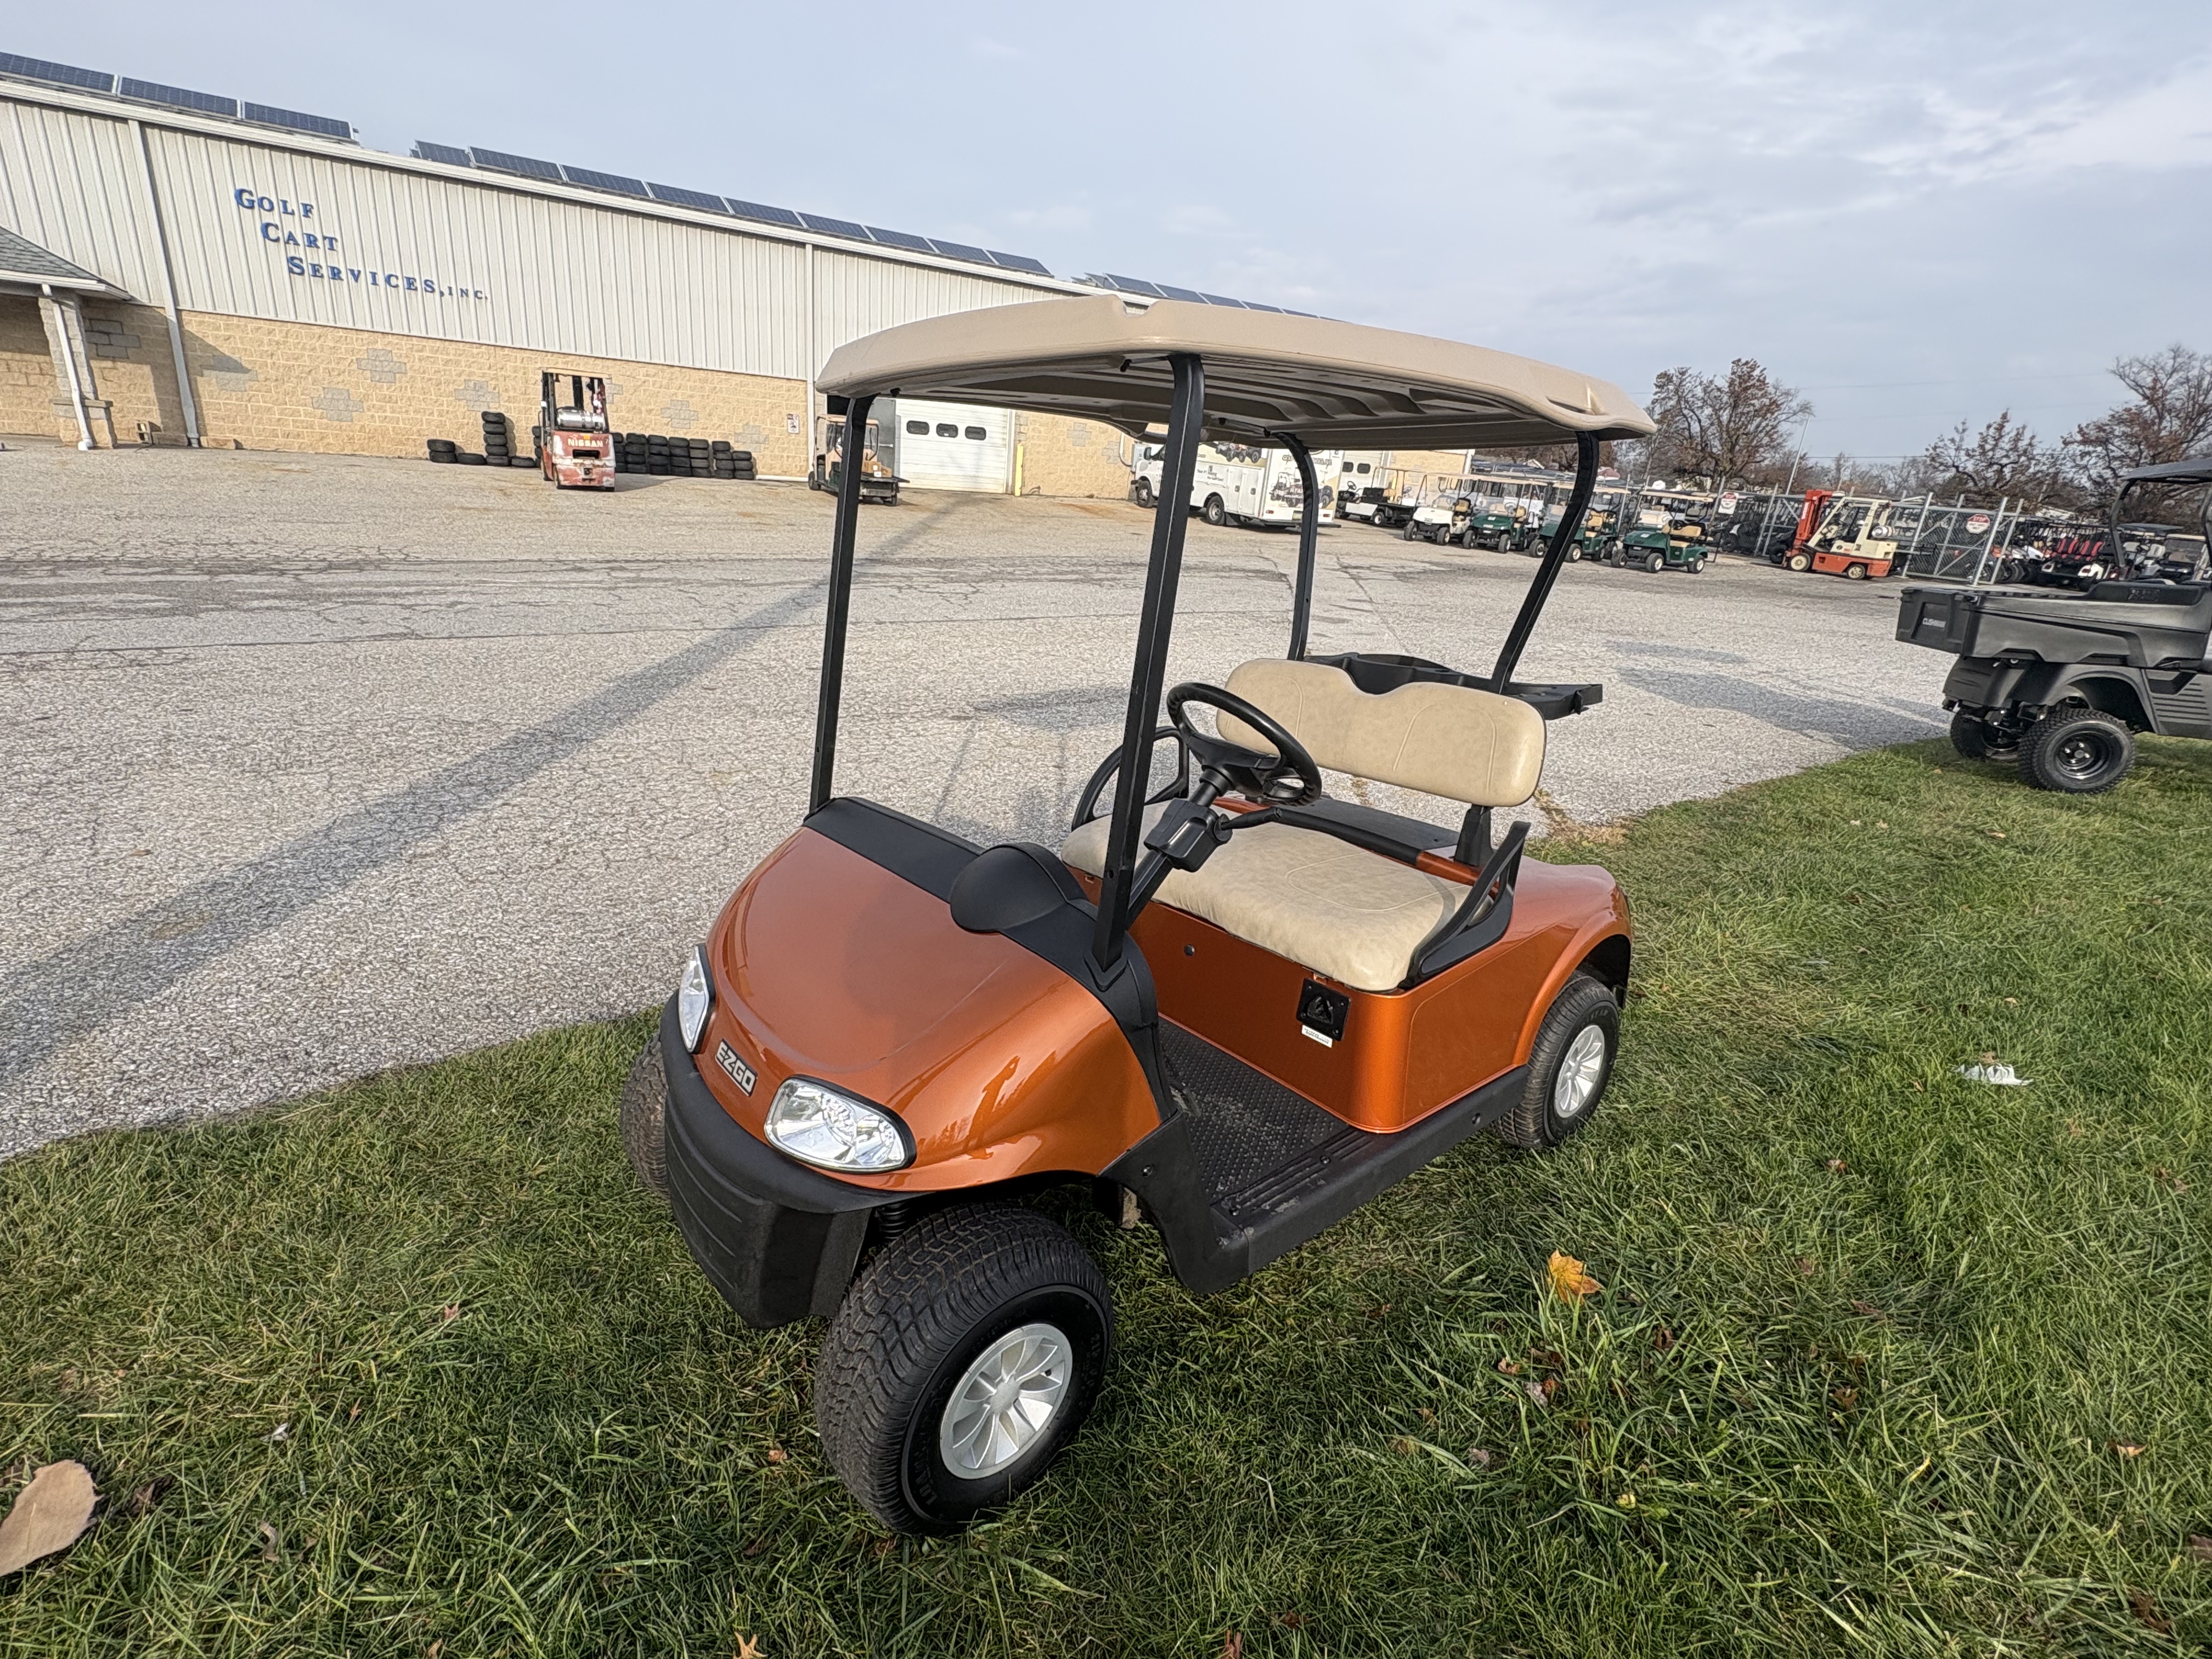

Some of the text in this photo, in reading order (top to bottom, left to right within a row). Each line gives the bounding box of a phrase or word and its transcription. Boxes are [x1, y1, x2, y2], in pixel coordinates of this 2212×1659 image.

[234, 188, 314, 218] GOLF
[261, 222, 338, 252] CART
[567, 438, 603, 448] NISSAN
